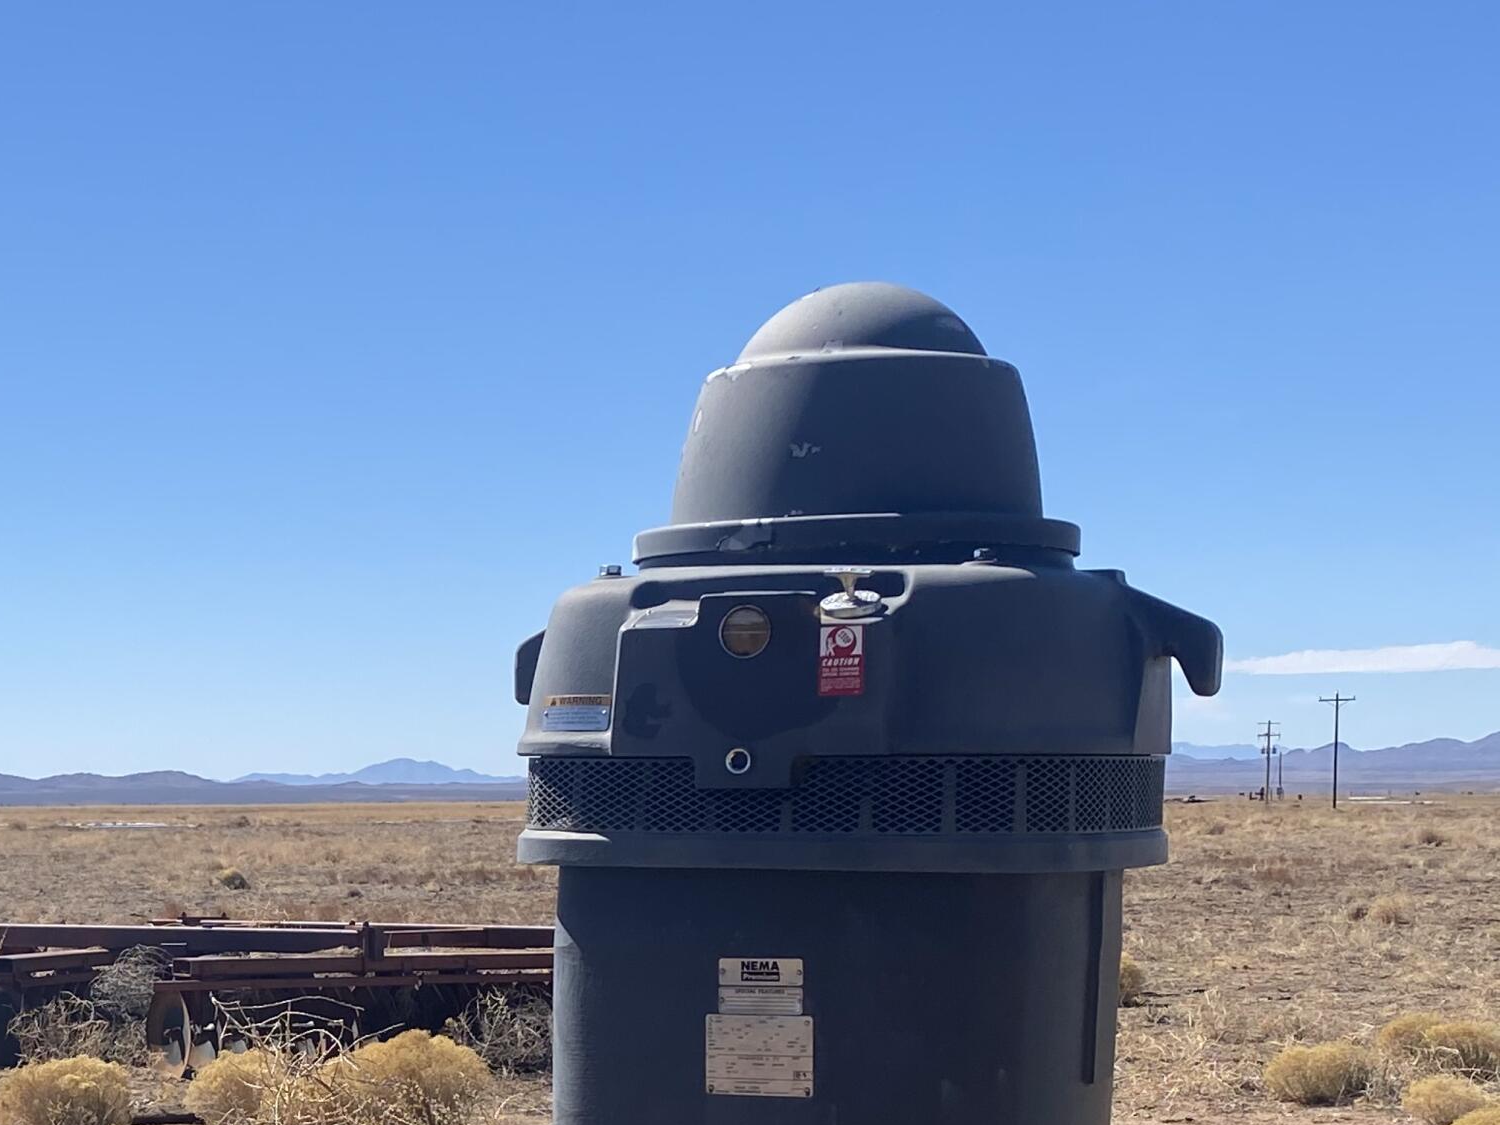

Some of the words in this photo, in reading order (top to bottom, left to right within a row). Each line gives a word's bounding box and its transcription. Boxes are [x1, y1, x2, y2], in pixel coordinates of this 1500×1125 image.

[822, 657, 860, 667] CAUTION
[559, 696, 602, 705] WARNING
[741, 961, 780, 971] NEMA
